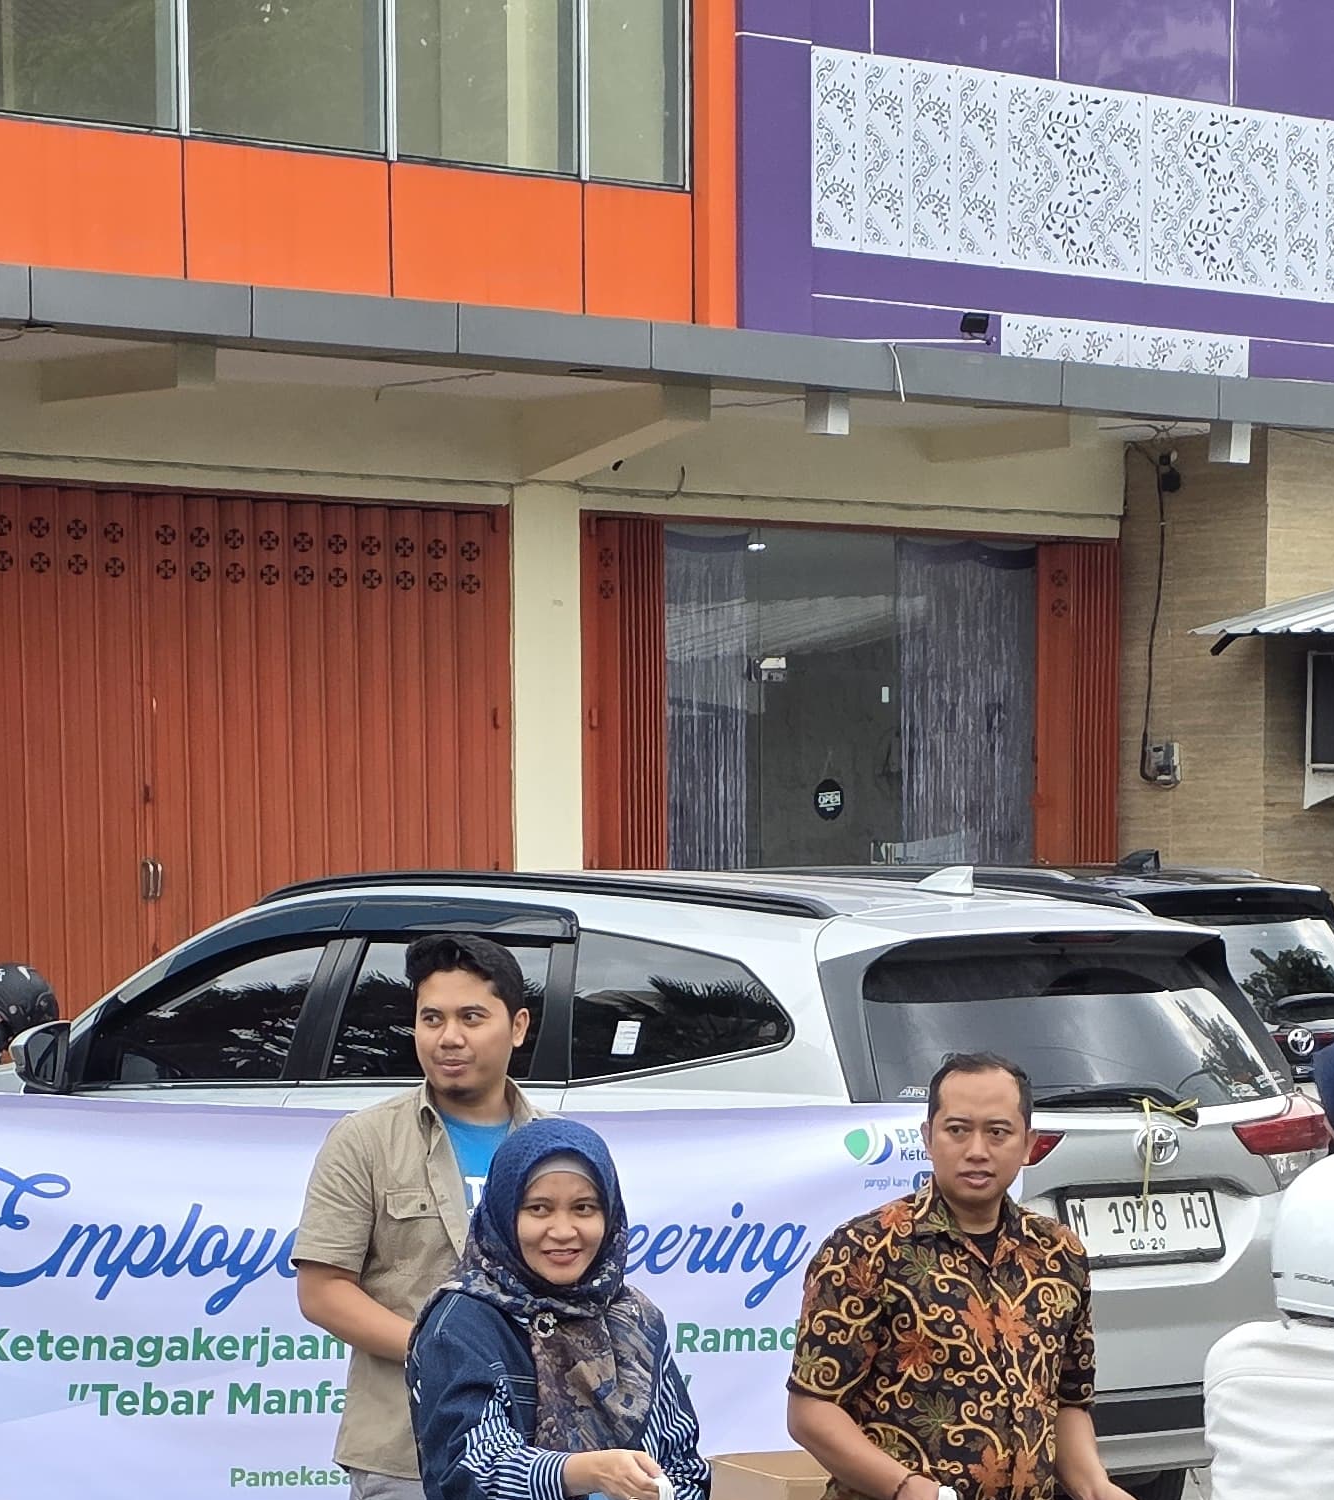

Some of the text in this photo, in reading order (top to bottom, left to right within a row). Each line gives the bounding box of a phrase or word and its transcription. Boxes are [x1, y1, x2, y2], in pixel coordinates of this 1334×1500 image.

[895, 1128, 924, 1145] BP
[1070, 1196, 1211, 1237] M 1978 HJ
